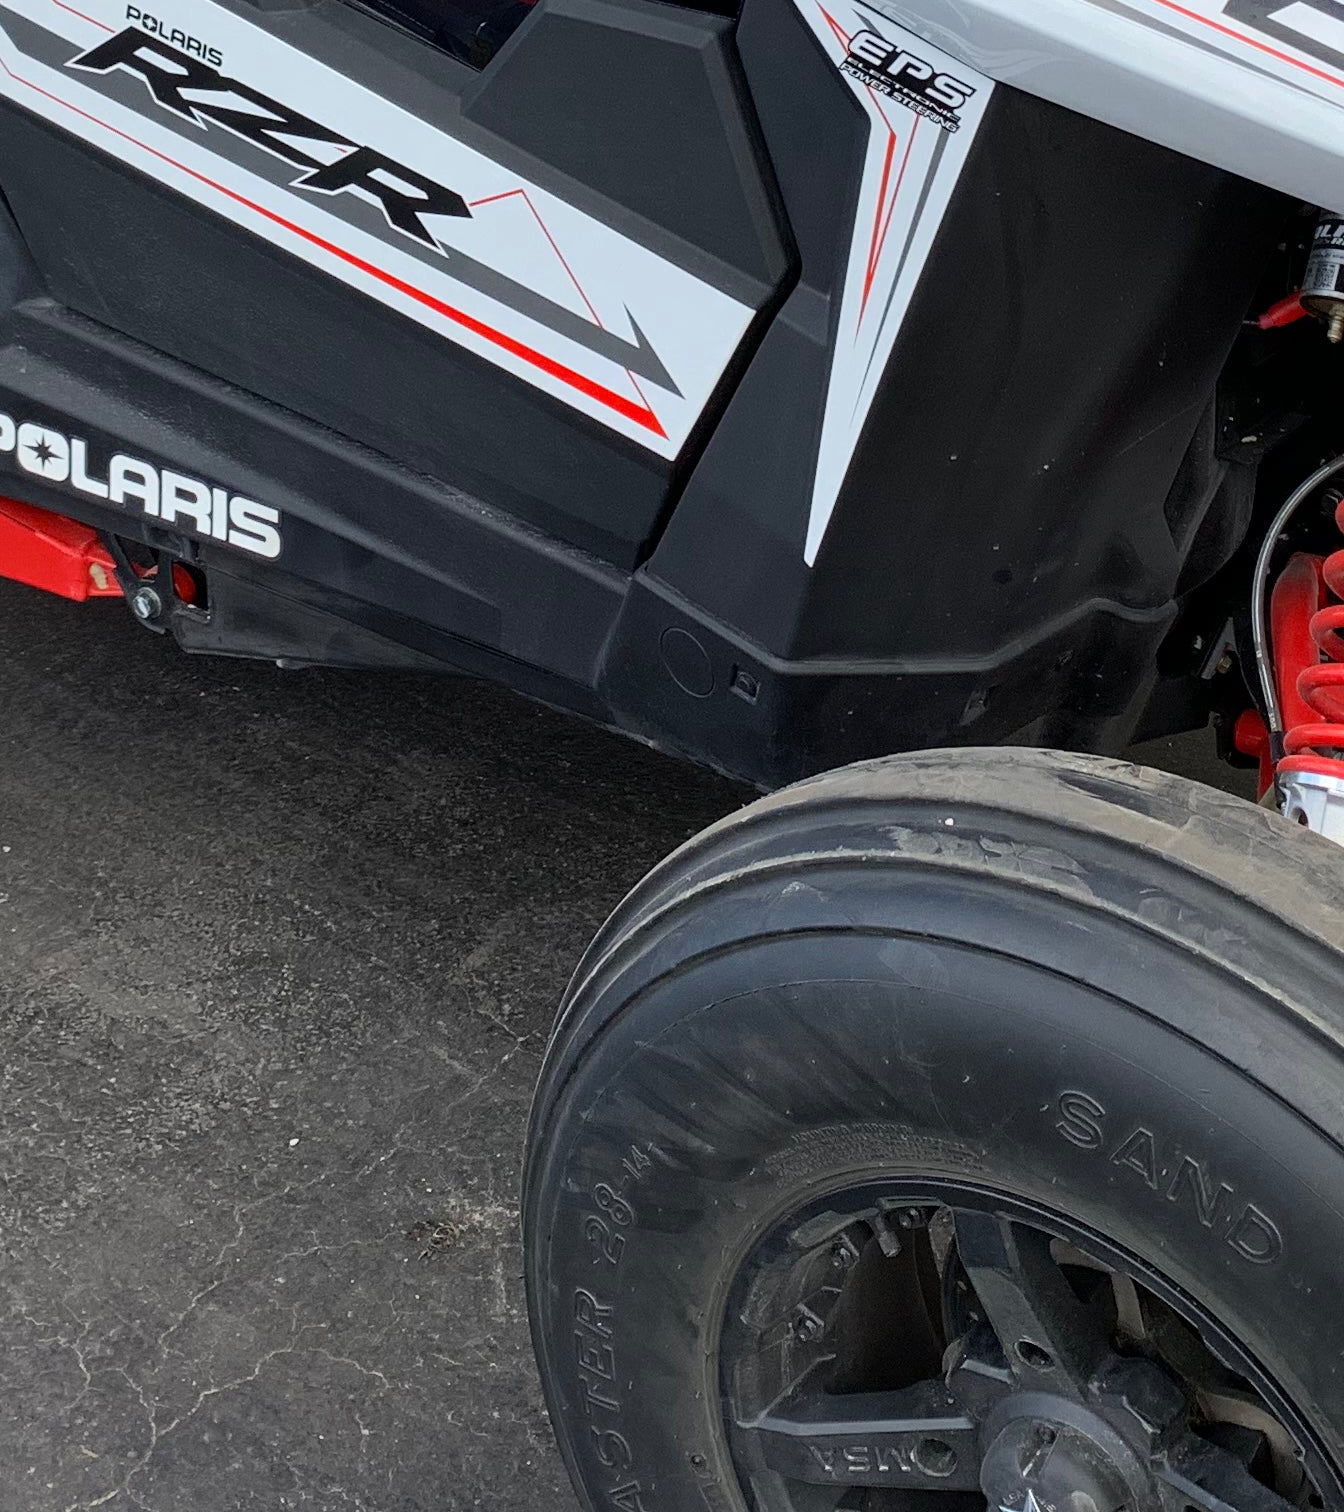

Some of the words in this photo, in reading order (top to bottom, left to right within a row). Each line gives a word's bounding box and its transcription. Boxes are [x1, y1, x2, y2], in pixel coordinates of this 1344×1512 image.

[125, 3, 224, 68] POLARIS
[848, 29, 976, 109] EPS
[840, 62, 889, 95] POWER
[890, 91, 959, 133] STEERING
[846, 56, 961, 122] ELECTRONIC
[66, 26, 474, 257] RZR
[1056, 1090, 1284, 1266] SAND
